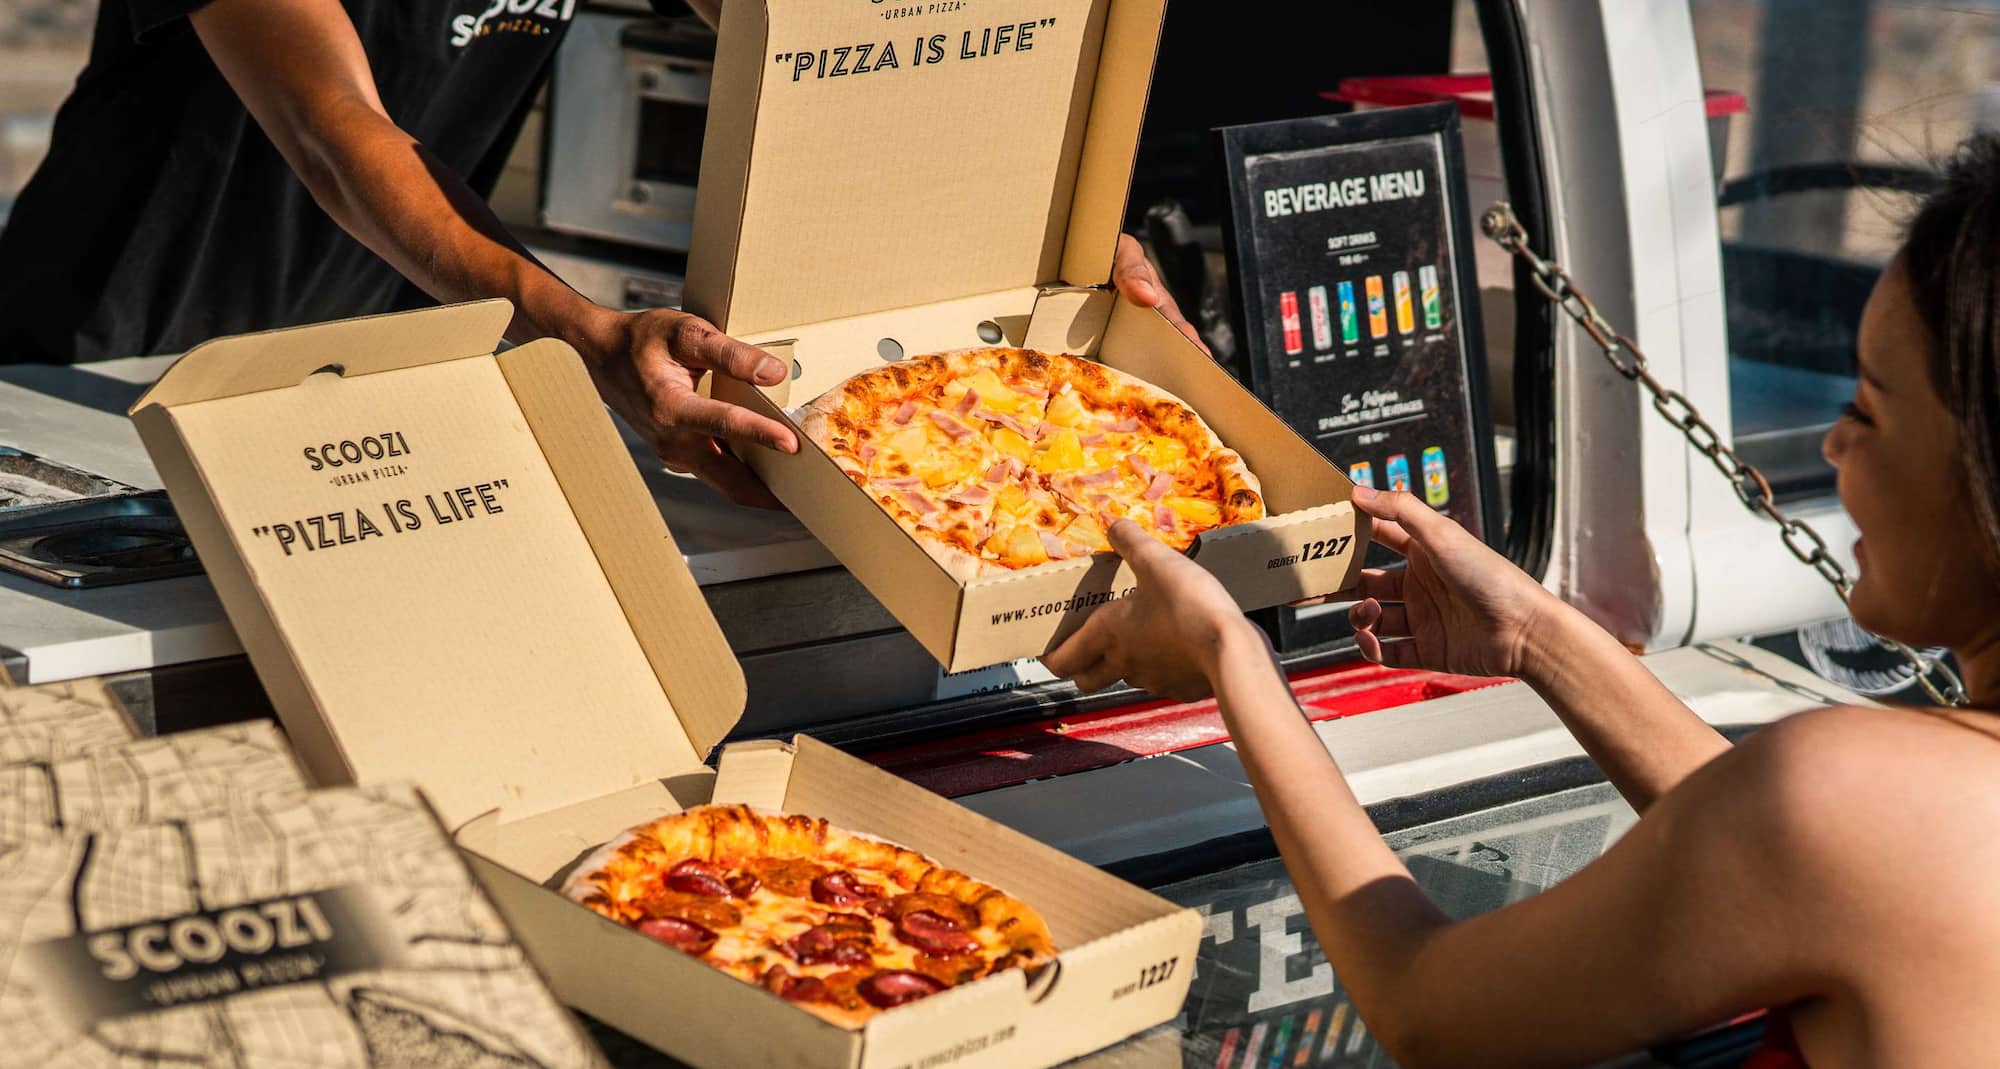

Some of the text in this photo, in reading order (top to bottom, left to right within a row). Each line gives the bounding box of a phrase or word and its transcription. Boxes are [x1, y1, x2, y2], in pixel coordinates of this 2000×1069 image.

[775, 17, 1056, 82] "PIZZA IS LIFE"
[1264, 169, 1425, 218] BEVERAGE MENU
[303, 431, 411, 471] SCOOZI
[252, 479, 509, 556] "PIZZA IS LIFE"
[1267, 535, 1353, 569] DELIVERY 1227
[86, 896, 334, 982] SCOOZI
[1139, 956, 1178, 990] 1227
